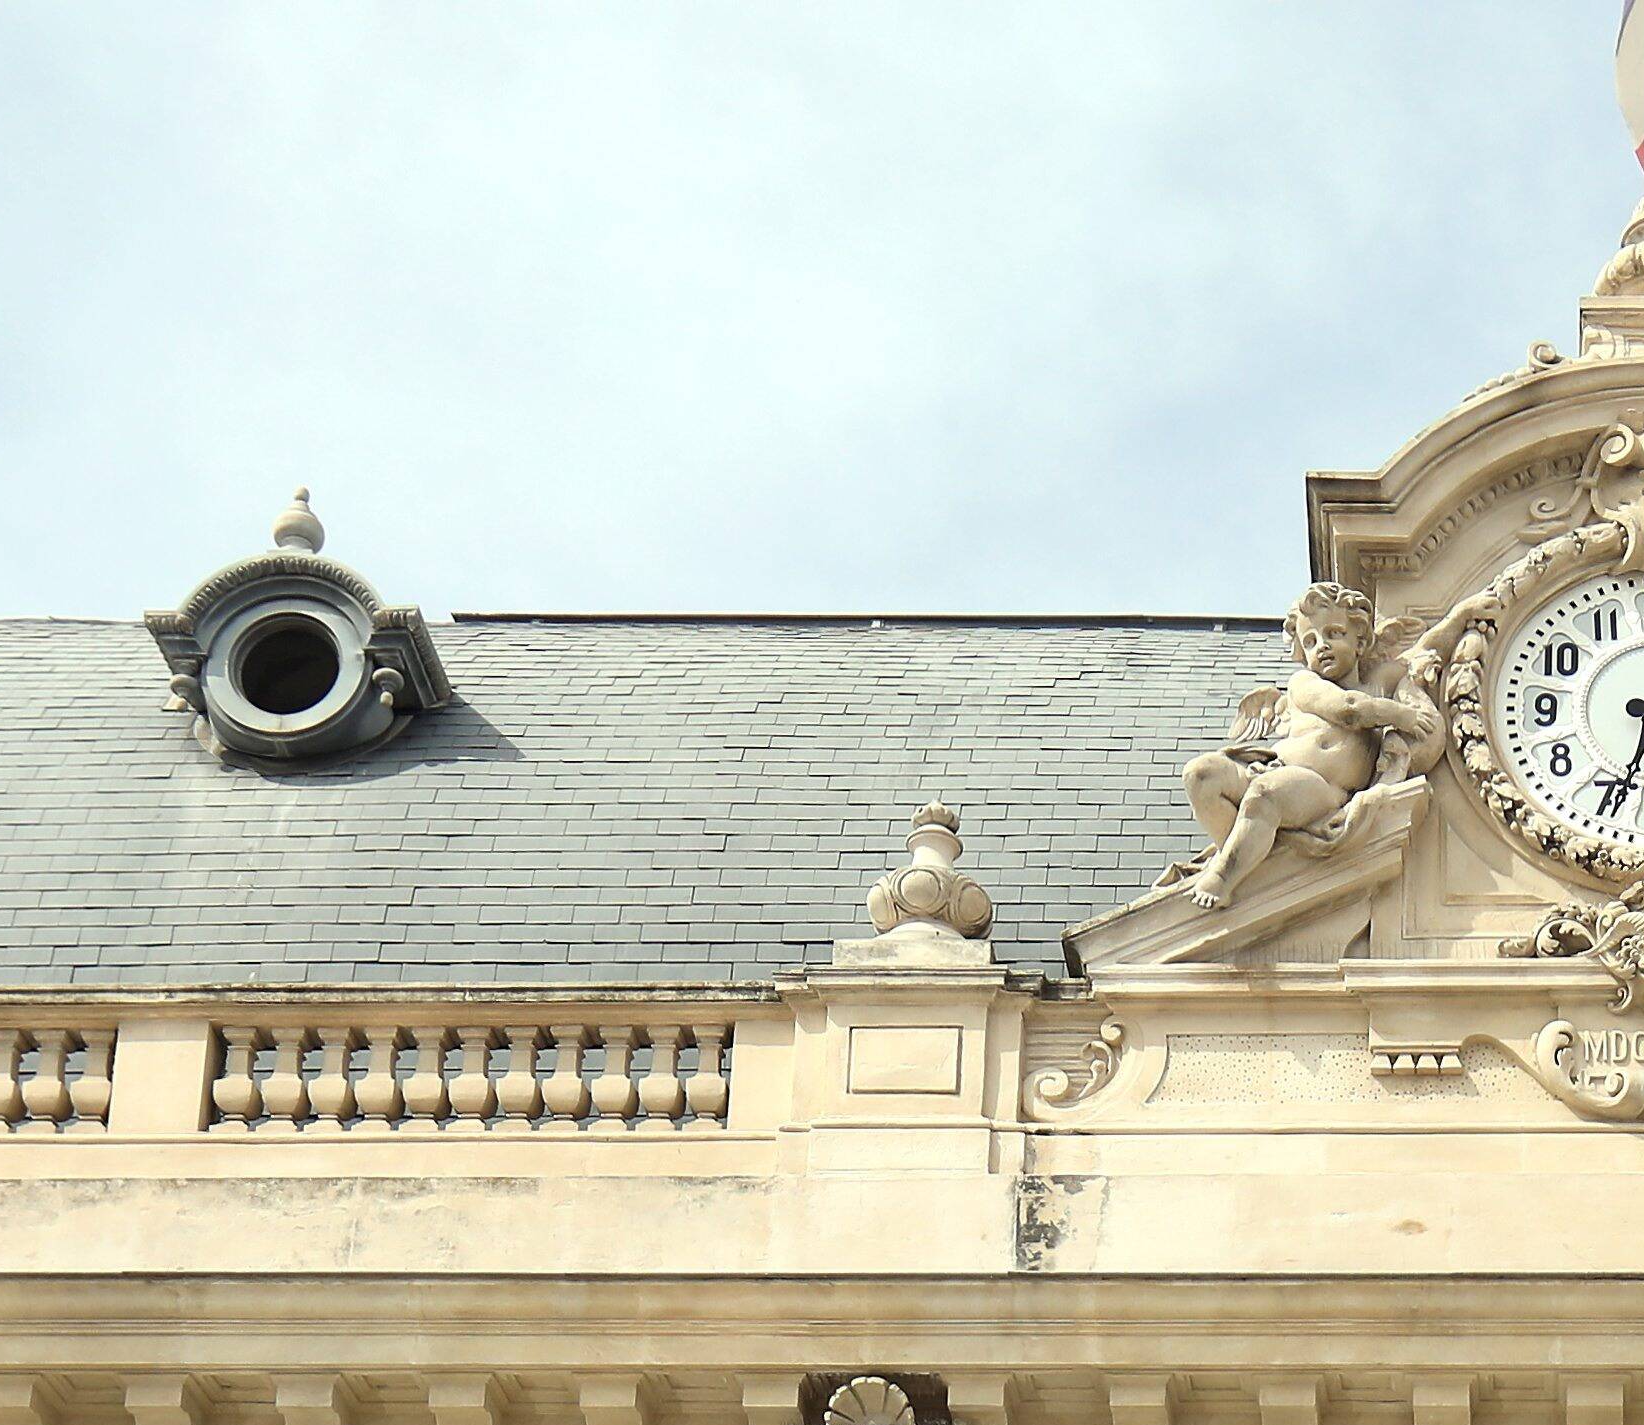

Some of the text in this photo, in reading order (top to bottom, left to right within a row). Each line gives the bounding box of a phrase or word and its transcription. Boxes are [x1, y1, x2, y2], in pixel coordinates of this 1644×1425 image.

[1593, 608, 1618, 641] 11
[1543, 642, 1579, 677] 10
[1534, 693, 1558, 727] 9
[1549, 743, 1573, 777] 8
[1594, 780, 1618, 816] 7
